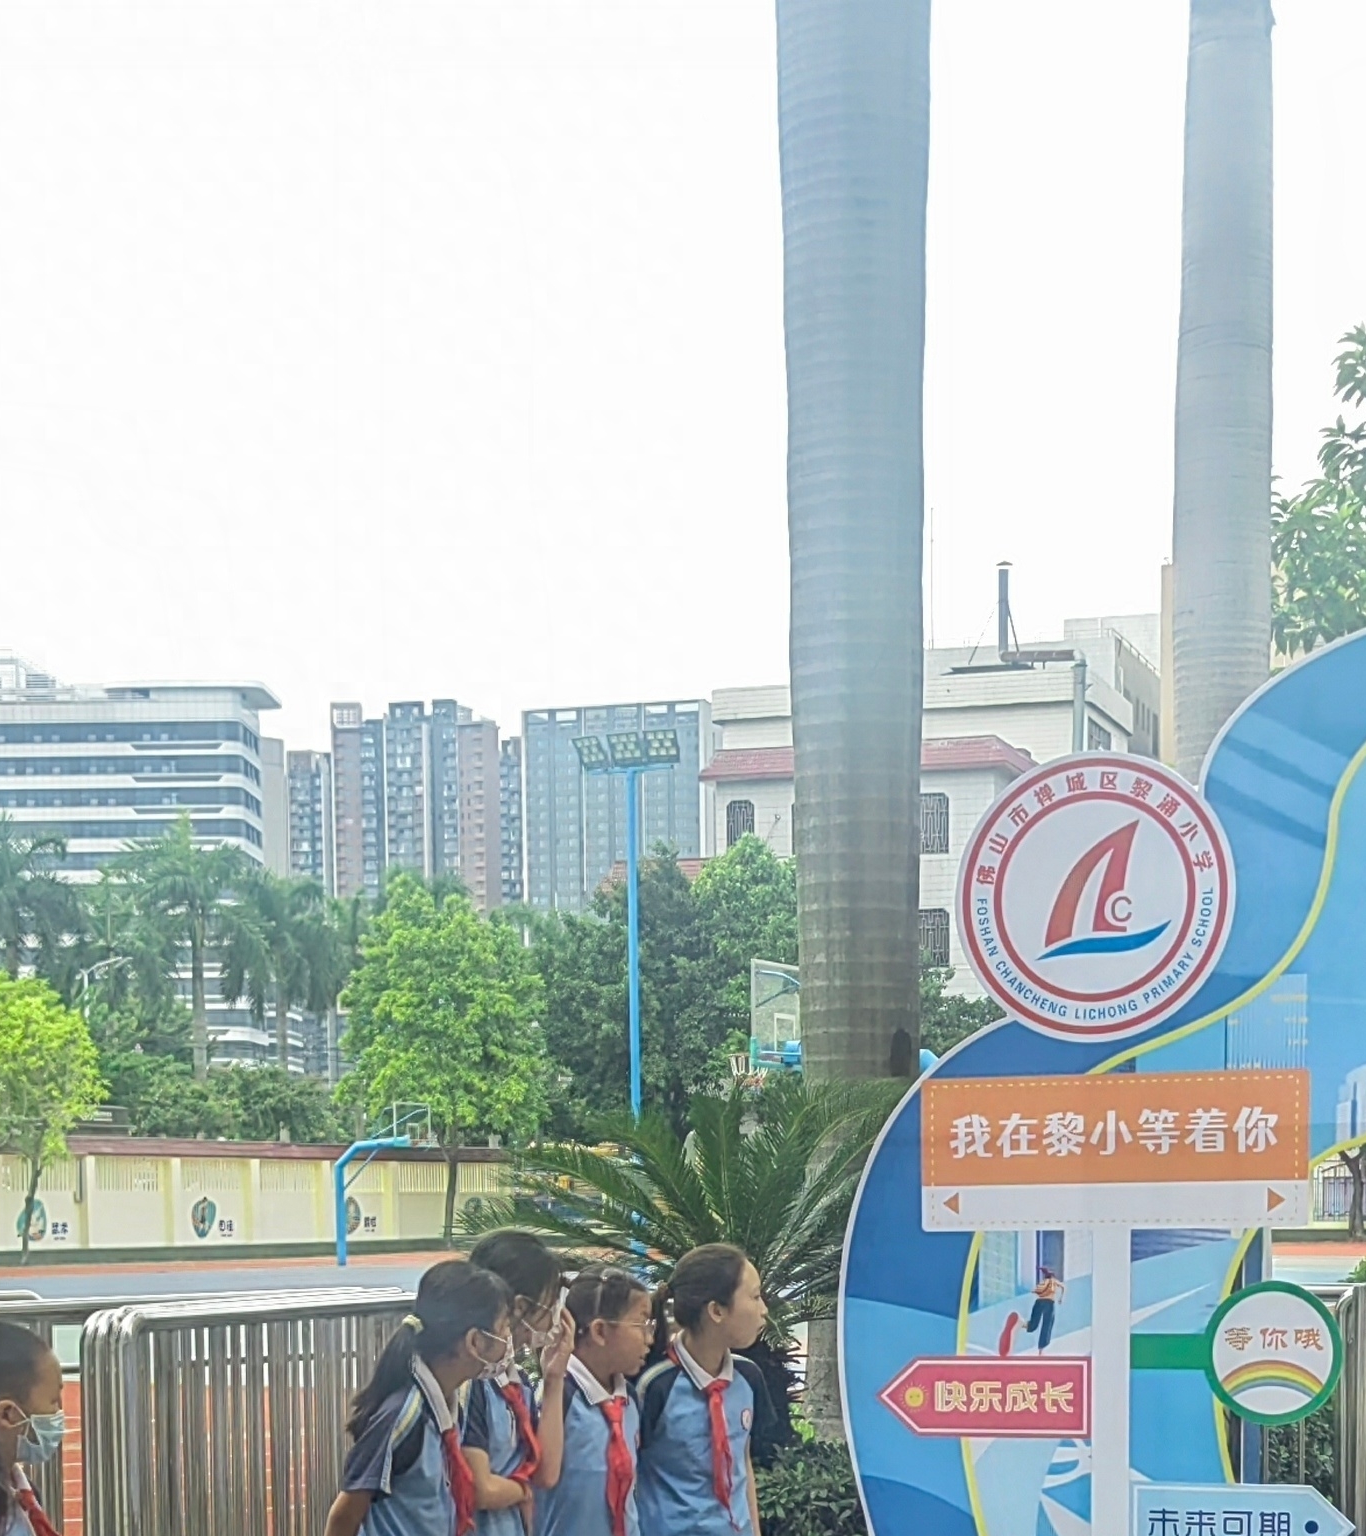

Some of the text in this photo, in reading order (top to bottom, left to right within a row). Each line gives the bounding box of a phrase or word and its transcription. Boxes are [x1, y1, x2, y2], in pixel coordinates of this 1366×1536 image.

[976, 770, 1215, 886] 佛山市禅城区黎涌小学
[976, 886, 1214, 1021] FOSHAN CHANCHENG LICHONG PRIMARY SCHOOL
[949, 1105, 1280, 1160] 我在黎小等着你
[1223, 1325, 1325, 1353] 等你哦
[933, 1379, 1075, 1415] 快乐成长
